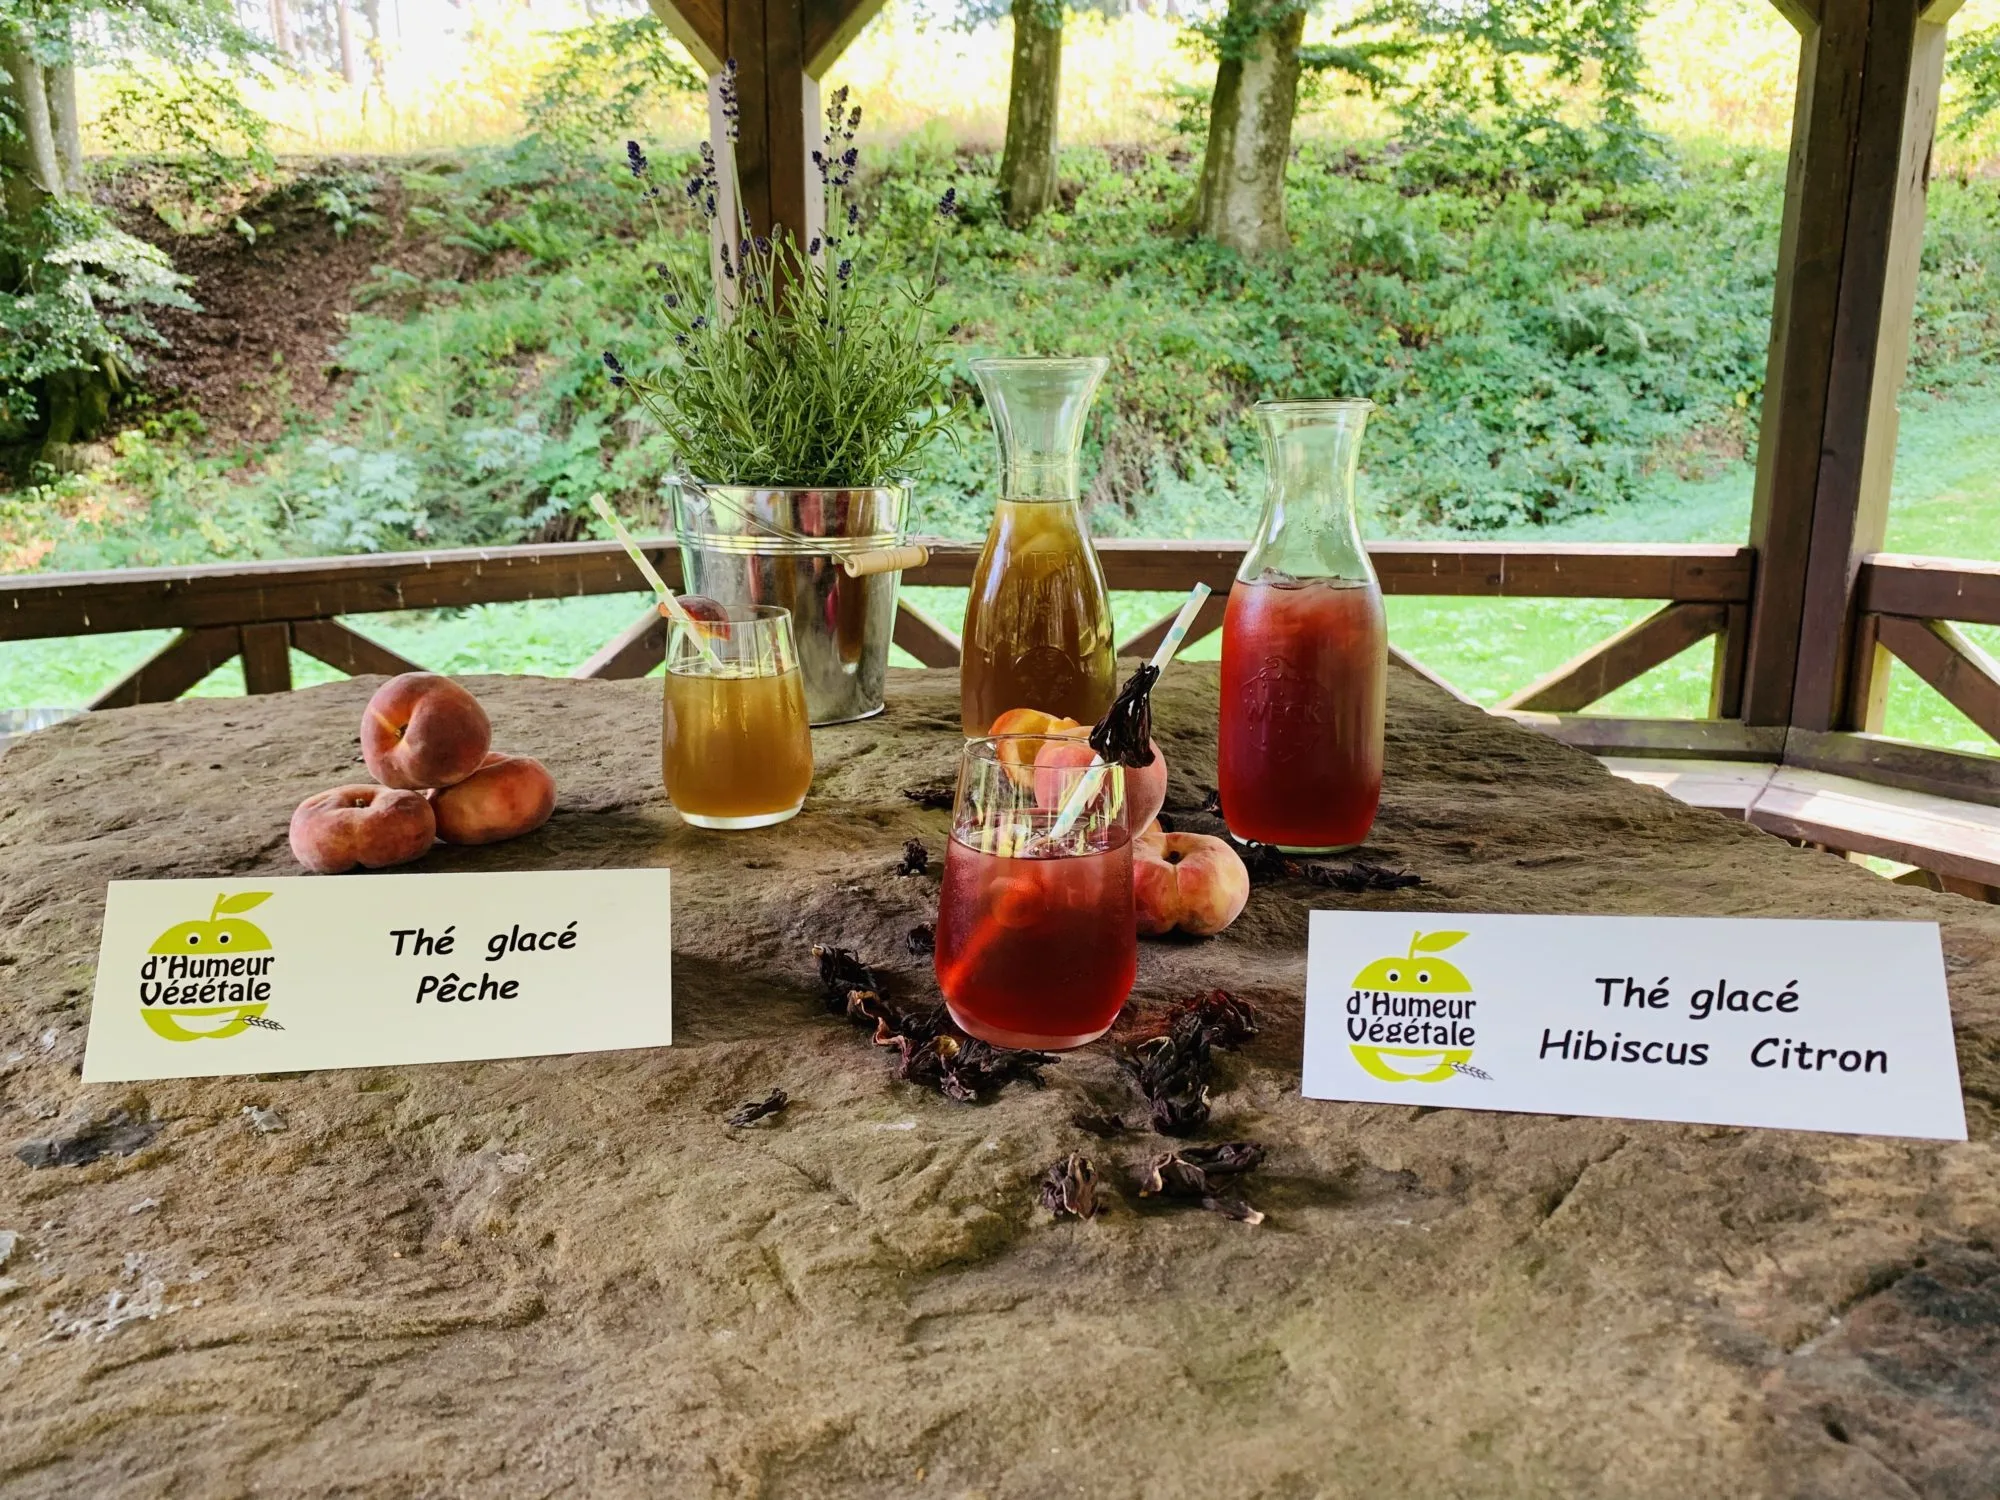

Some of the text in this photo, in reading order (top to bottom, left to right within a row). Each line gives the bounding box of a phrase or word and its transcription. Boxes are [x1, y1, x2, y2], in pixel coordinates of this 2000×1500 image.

[389, 920, 578, 962] Thé glacé
[140, 955, 275, 980] d'Humeur
[139, 978, 272, 1007] Végétale
[415, 972, 520, 1004] Pêche
[1595, 976, 1799, 1020] Thé glacé
[1346, 990, 1477, 1020] d'Humeur
[1347, 1016, 1476, 1047] Végétale
[1539, 1028, 1887, 1074] Hibiscus Citron
